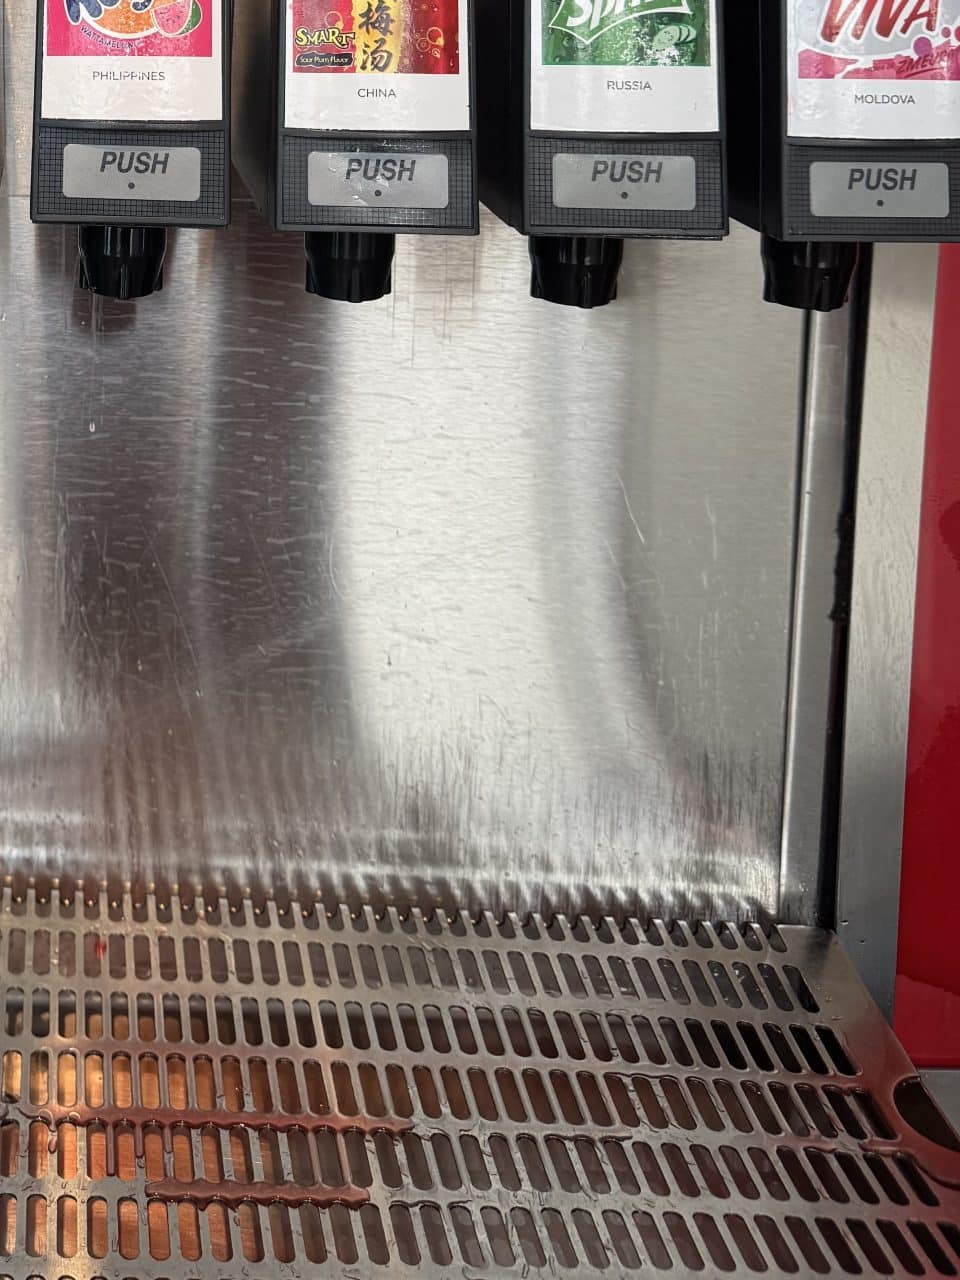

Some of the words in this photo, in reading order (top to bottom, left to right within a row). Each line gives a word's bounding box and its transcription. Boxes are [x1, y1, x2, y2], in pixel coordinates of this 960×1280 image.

[295, 27, 356, 50] SMART
[92, 70, 166, 81] PHILIPPINES
[607, 81, 652, 91] RUSSIA
[357, 87, 397, 99] CHINA
[854, 95, 916, 106] MOLDOVA
[99, 150, 169, 175] PUSH
[345, 158, 416, 183] PUSH
[591, 160, 663, 185] PUSH
[847, 168, 917, 192] PUSH
